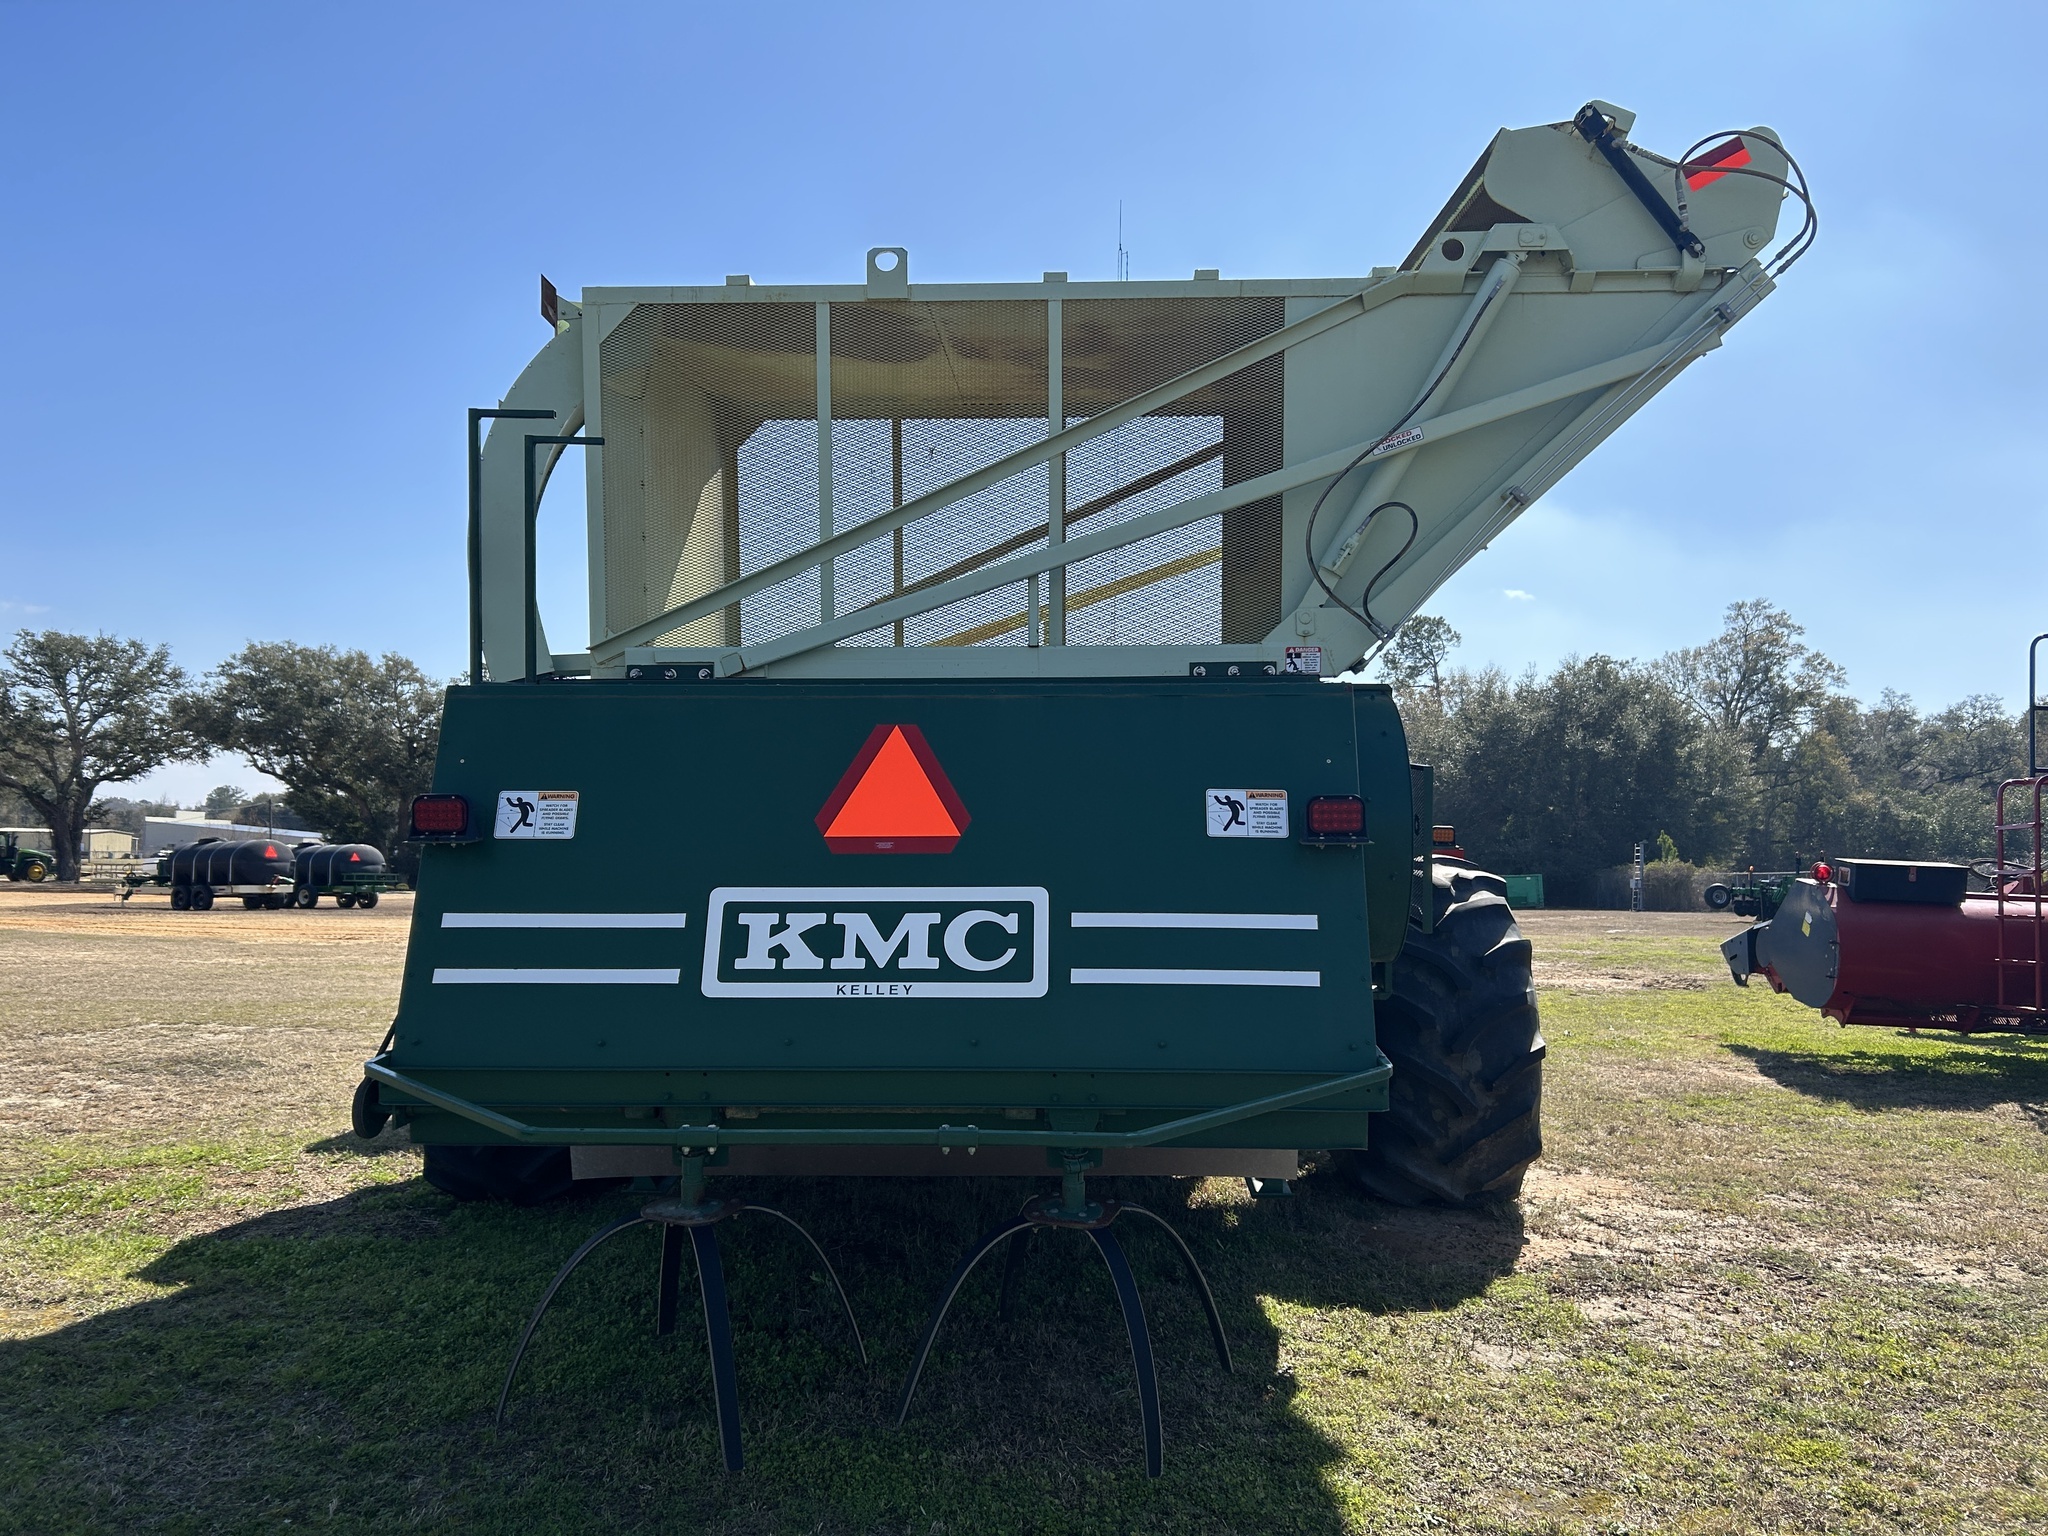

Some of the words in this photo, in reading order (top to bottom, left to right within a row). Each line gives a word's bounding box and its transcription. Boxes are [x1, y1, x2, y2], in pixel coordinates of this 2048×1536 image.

[1382, 433, 1421, 451] UNLOCKED
[734, 909, 1019, 972] KMC
[836, 984, 914, 996] KELLEY
